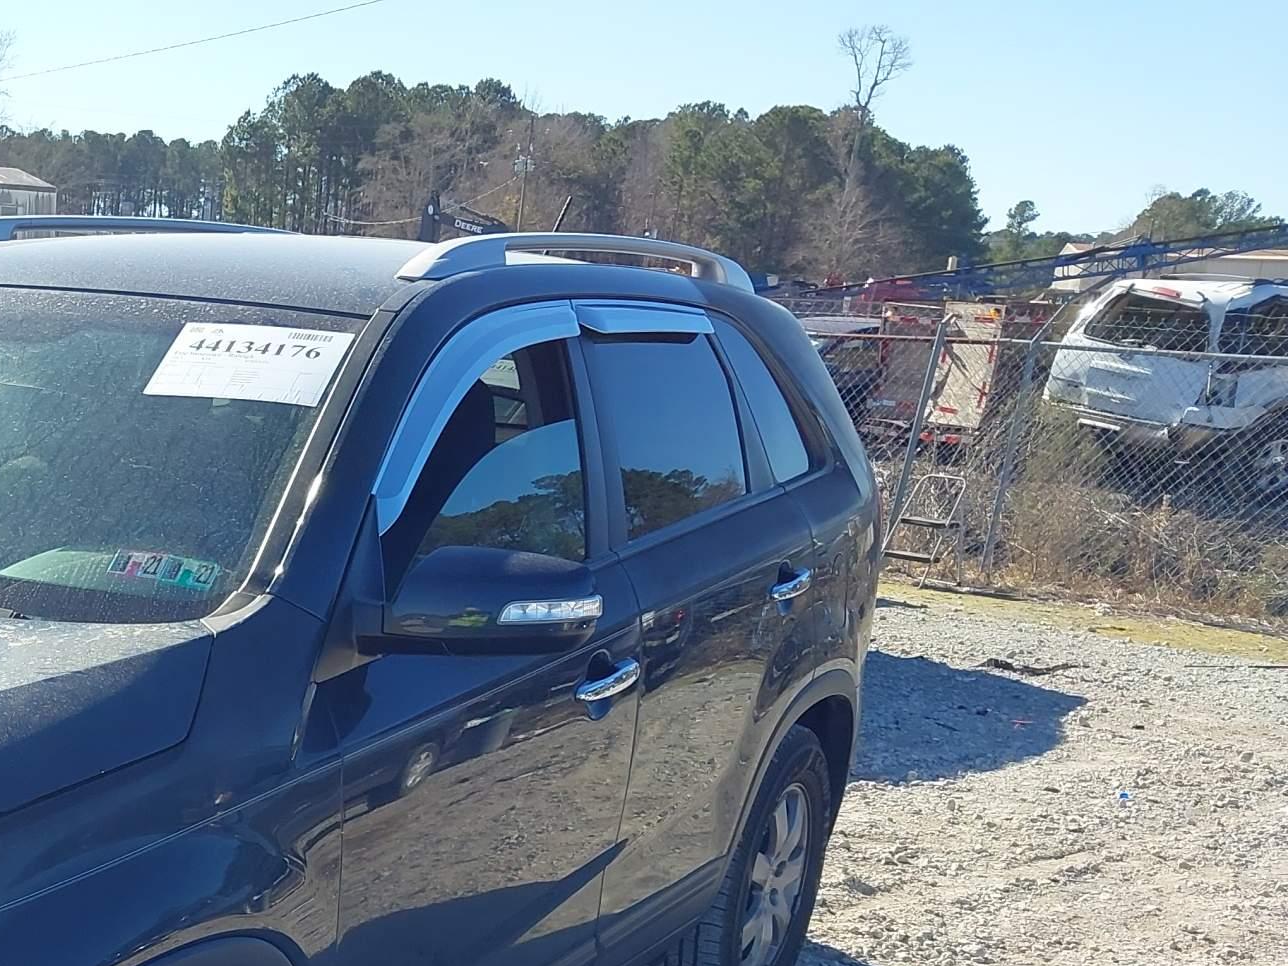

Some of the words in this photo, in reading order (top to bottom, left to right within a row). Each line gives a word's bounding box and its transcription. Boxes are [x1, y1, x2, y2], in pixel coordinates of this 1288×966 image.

[455, 220, 484, 233] DEERE
[189, 338, 326, 360] 44134176
[143, 554, 163, 575] 21
[196, 564, 215, 585] 21
